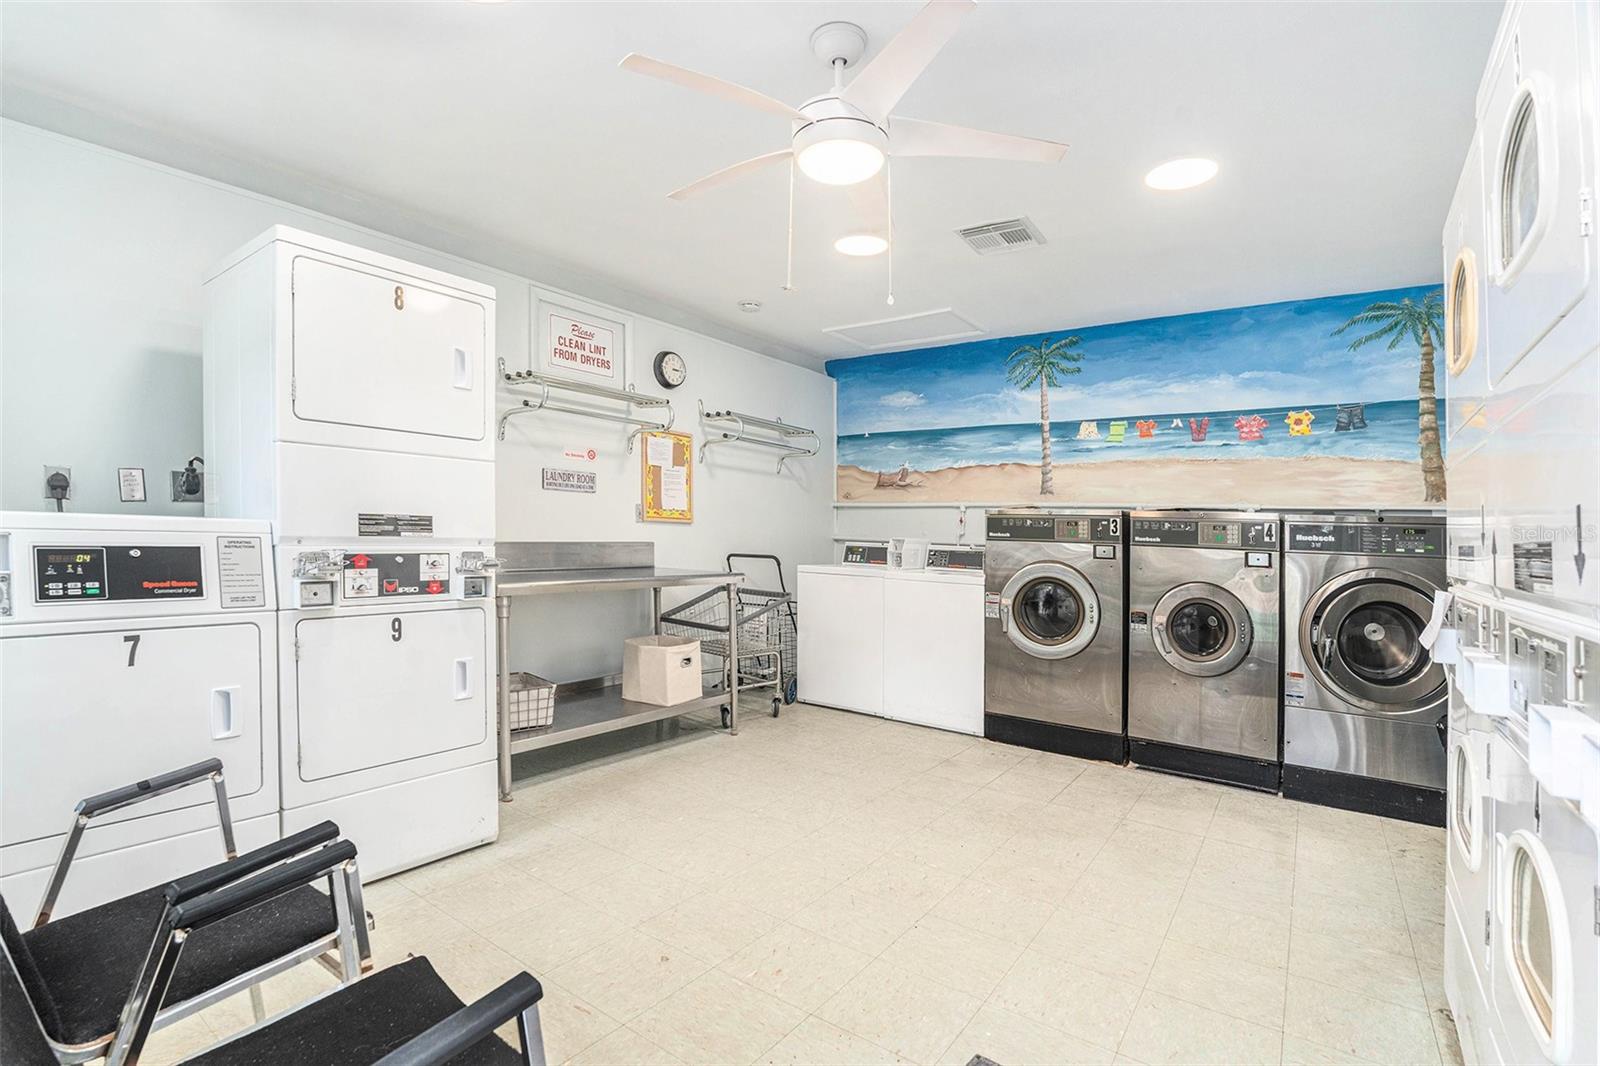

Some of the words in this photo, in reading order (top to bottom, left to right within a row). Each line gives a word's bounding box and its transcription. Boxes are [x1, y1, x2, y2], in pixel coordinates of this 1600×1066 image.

[395, 286, 404, 311] 8
[571, 323, 596, 340] Please
[558, 336, 587, 352] CLEAN
[589, 343, 607, 356] LINT
[553, 347, 578, 362] FROM
[580, 354, 611, 370] DRYERS
[545, 470, 576, 482] LAUNDRY
[576, 474, 596, 485] ROOM
[1111, 519, 1118, 534] 3
[1265, 524, 1274, 541] 4
[1296, 534, 1335, 542] Huebsch
[392, 617, 402, 642] 9
[124, 634, 140, 667] 7
